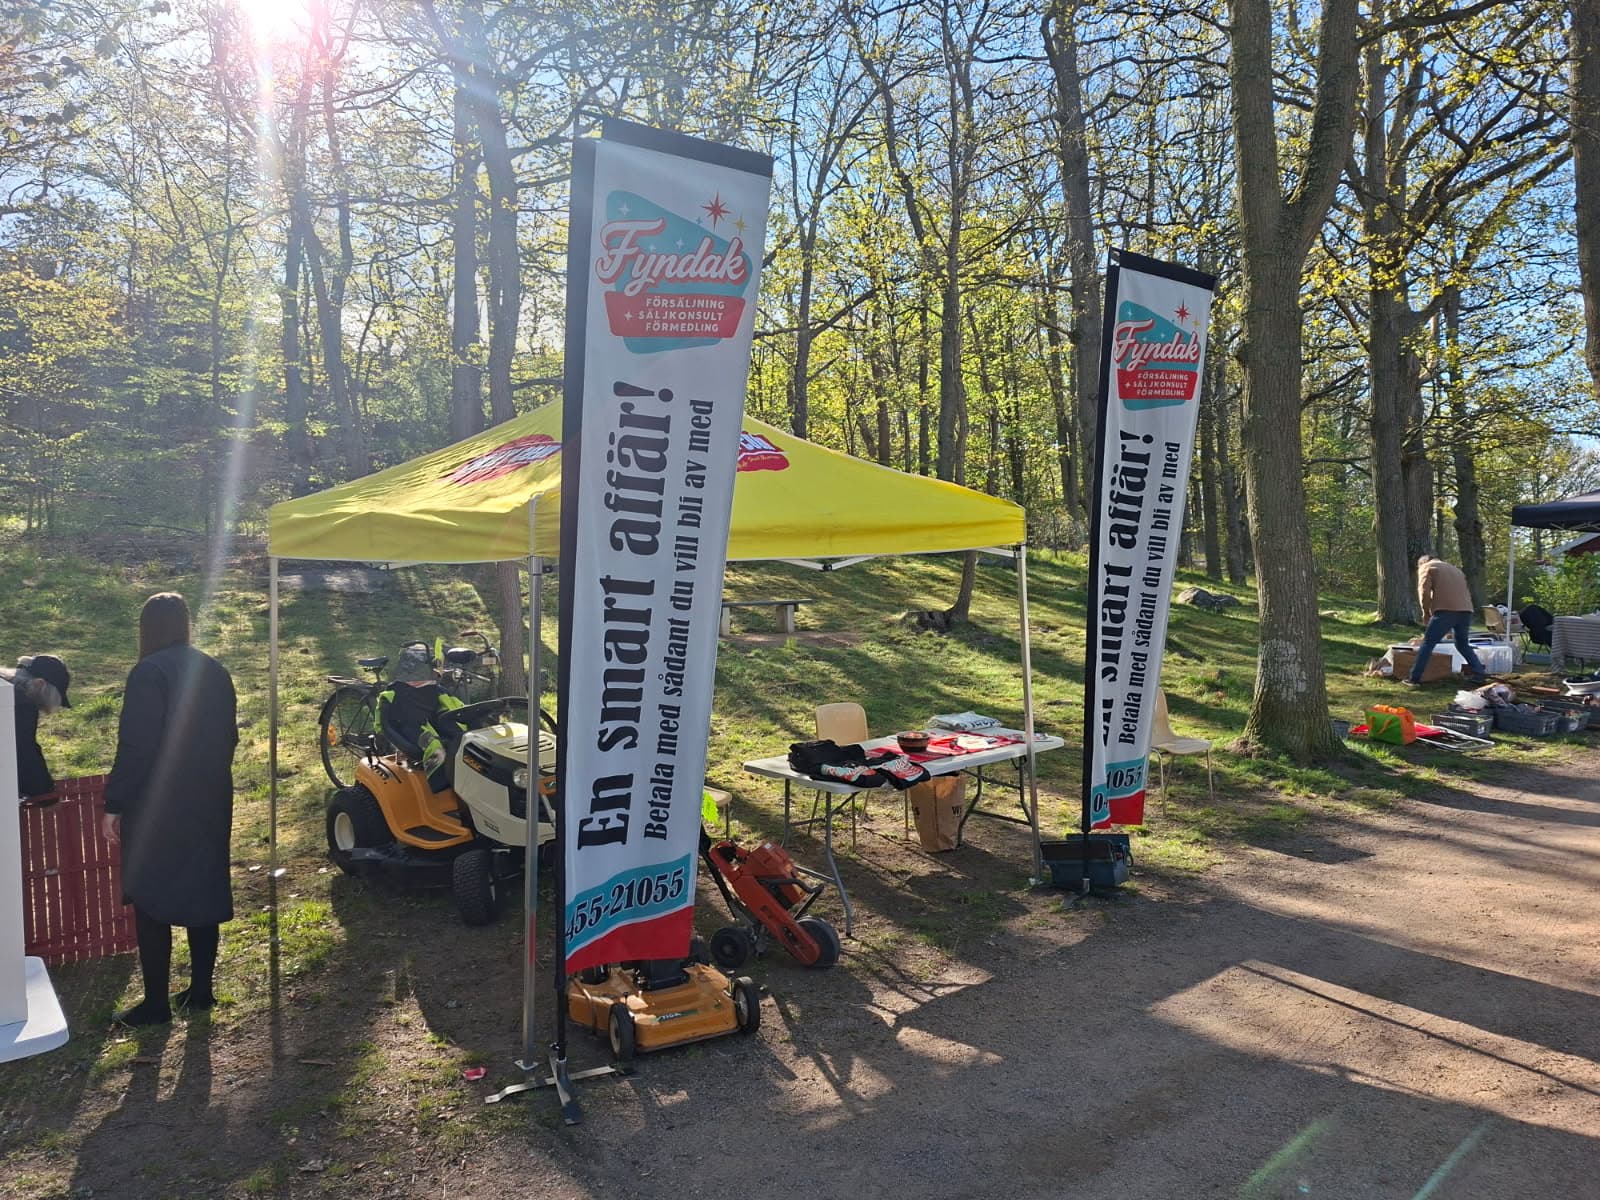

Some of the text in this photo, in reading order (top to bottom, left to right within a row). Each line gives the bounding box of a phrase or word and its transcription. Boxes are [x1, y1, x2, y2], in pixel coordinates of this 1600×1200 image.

[595, 217, 748, 297] Fyndak
[639, 310, 723, 321] SÄLJKONSULT
[645, 321, 719, 332] FÖRMEDLING
[646, 298, 725, 310] FÖRSÄLJNING
[1113, 318, 1200, 372] Fyndak
[1133, 380, 1188, 389] SÄLJKONSULT
[1136, 388, 1184, 397] FÖRMEDLING
[1108, 429, 1154, 550] affär!
[577, 381, 674, 850] En smart affär!
[644, 400, 713, 841] Betala med sådant du vill bli av med
[1118, 442, 1180, 746] Betala med sådant du vill bli av med
